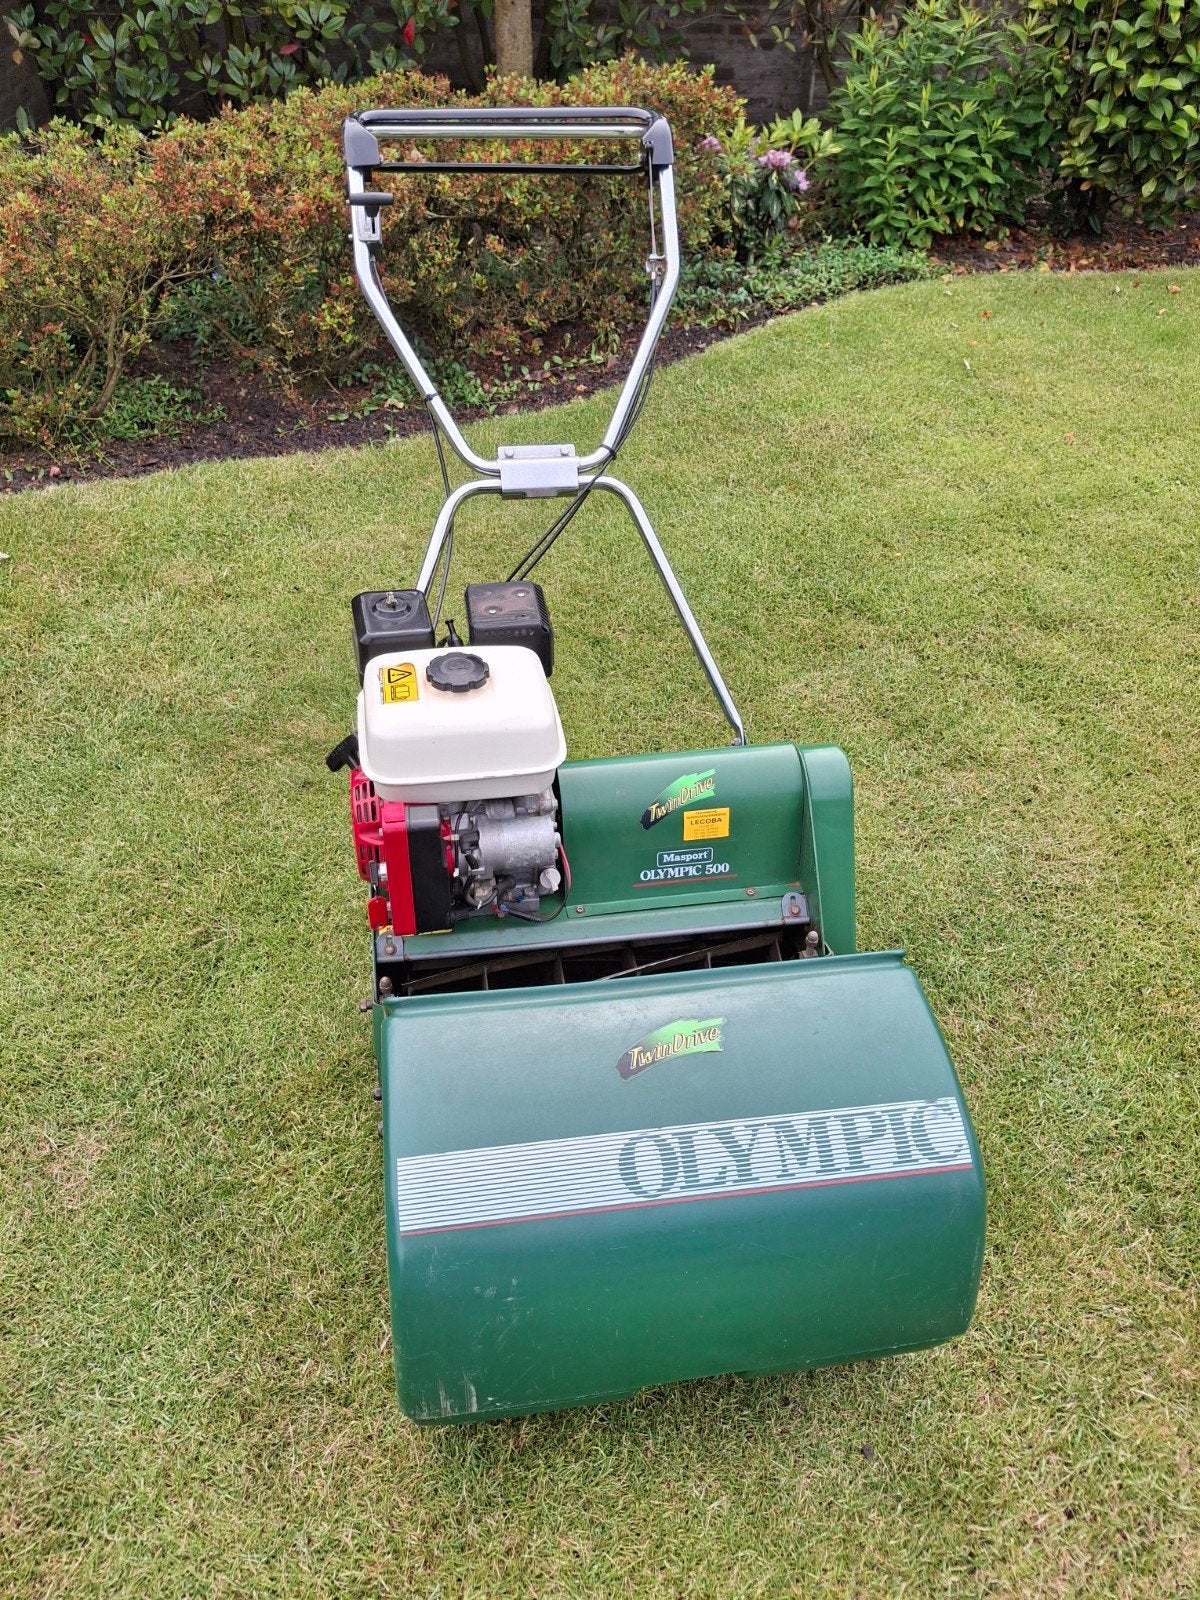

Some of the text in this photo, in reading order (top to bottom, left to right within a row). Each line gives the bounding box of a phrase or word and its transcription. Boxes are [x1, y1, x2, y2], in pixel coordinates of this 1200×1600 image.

[649, 777, 713, 822] TwinDrive
[690, 817, 722, 825] LECOBA
[663, 851, 708, 862] Masport
[640, 863, 730, 880] OLYMPIC 500
[629, 1027, 719, 1069] TwinDrive
[618, 1101, 967, 1199] OLYMPIC
